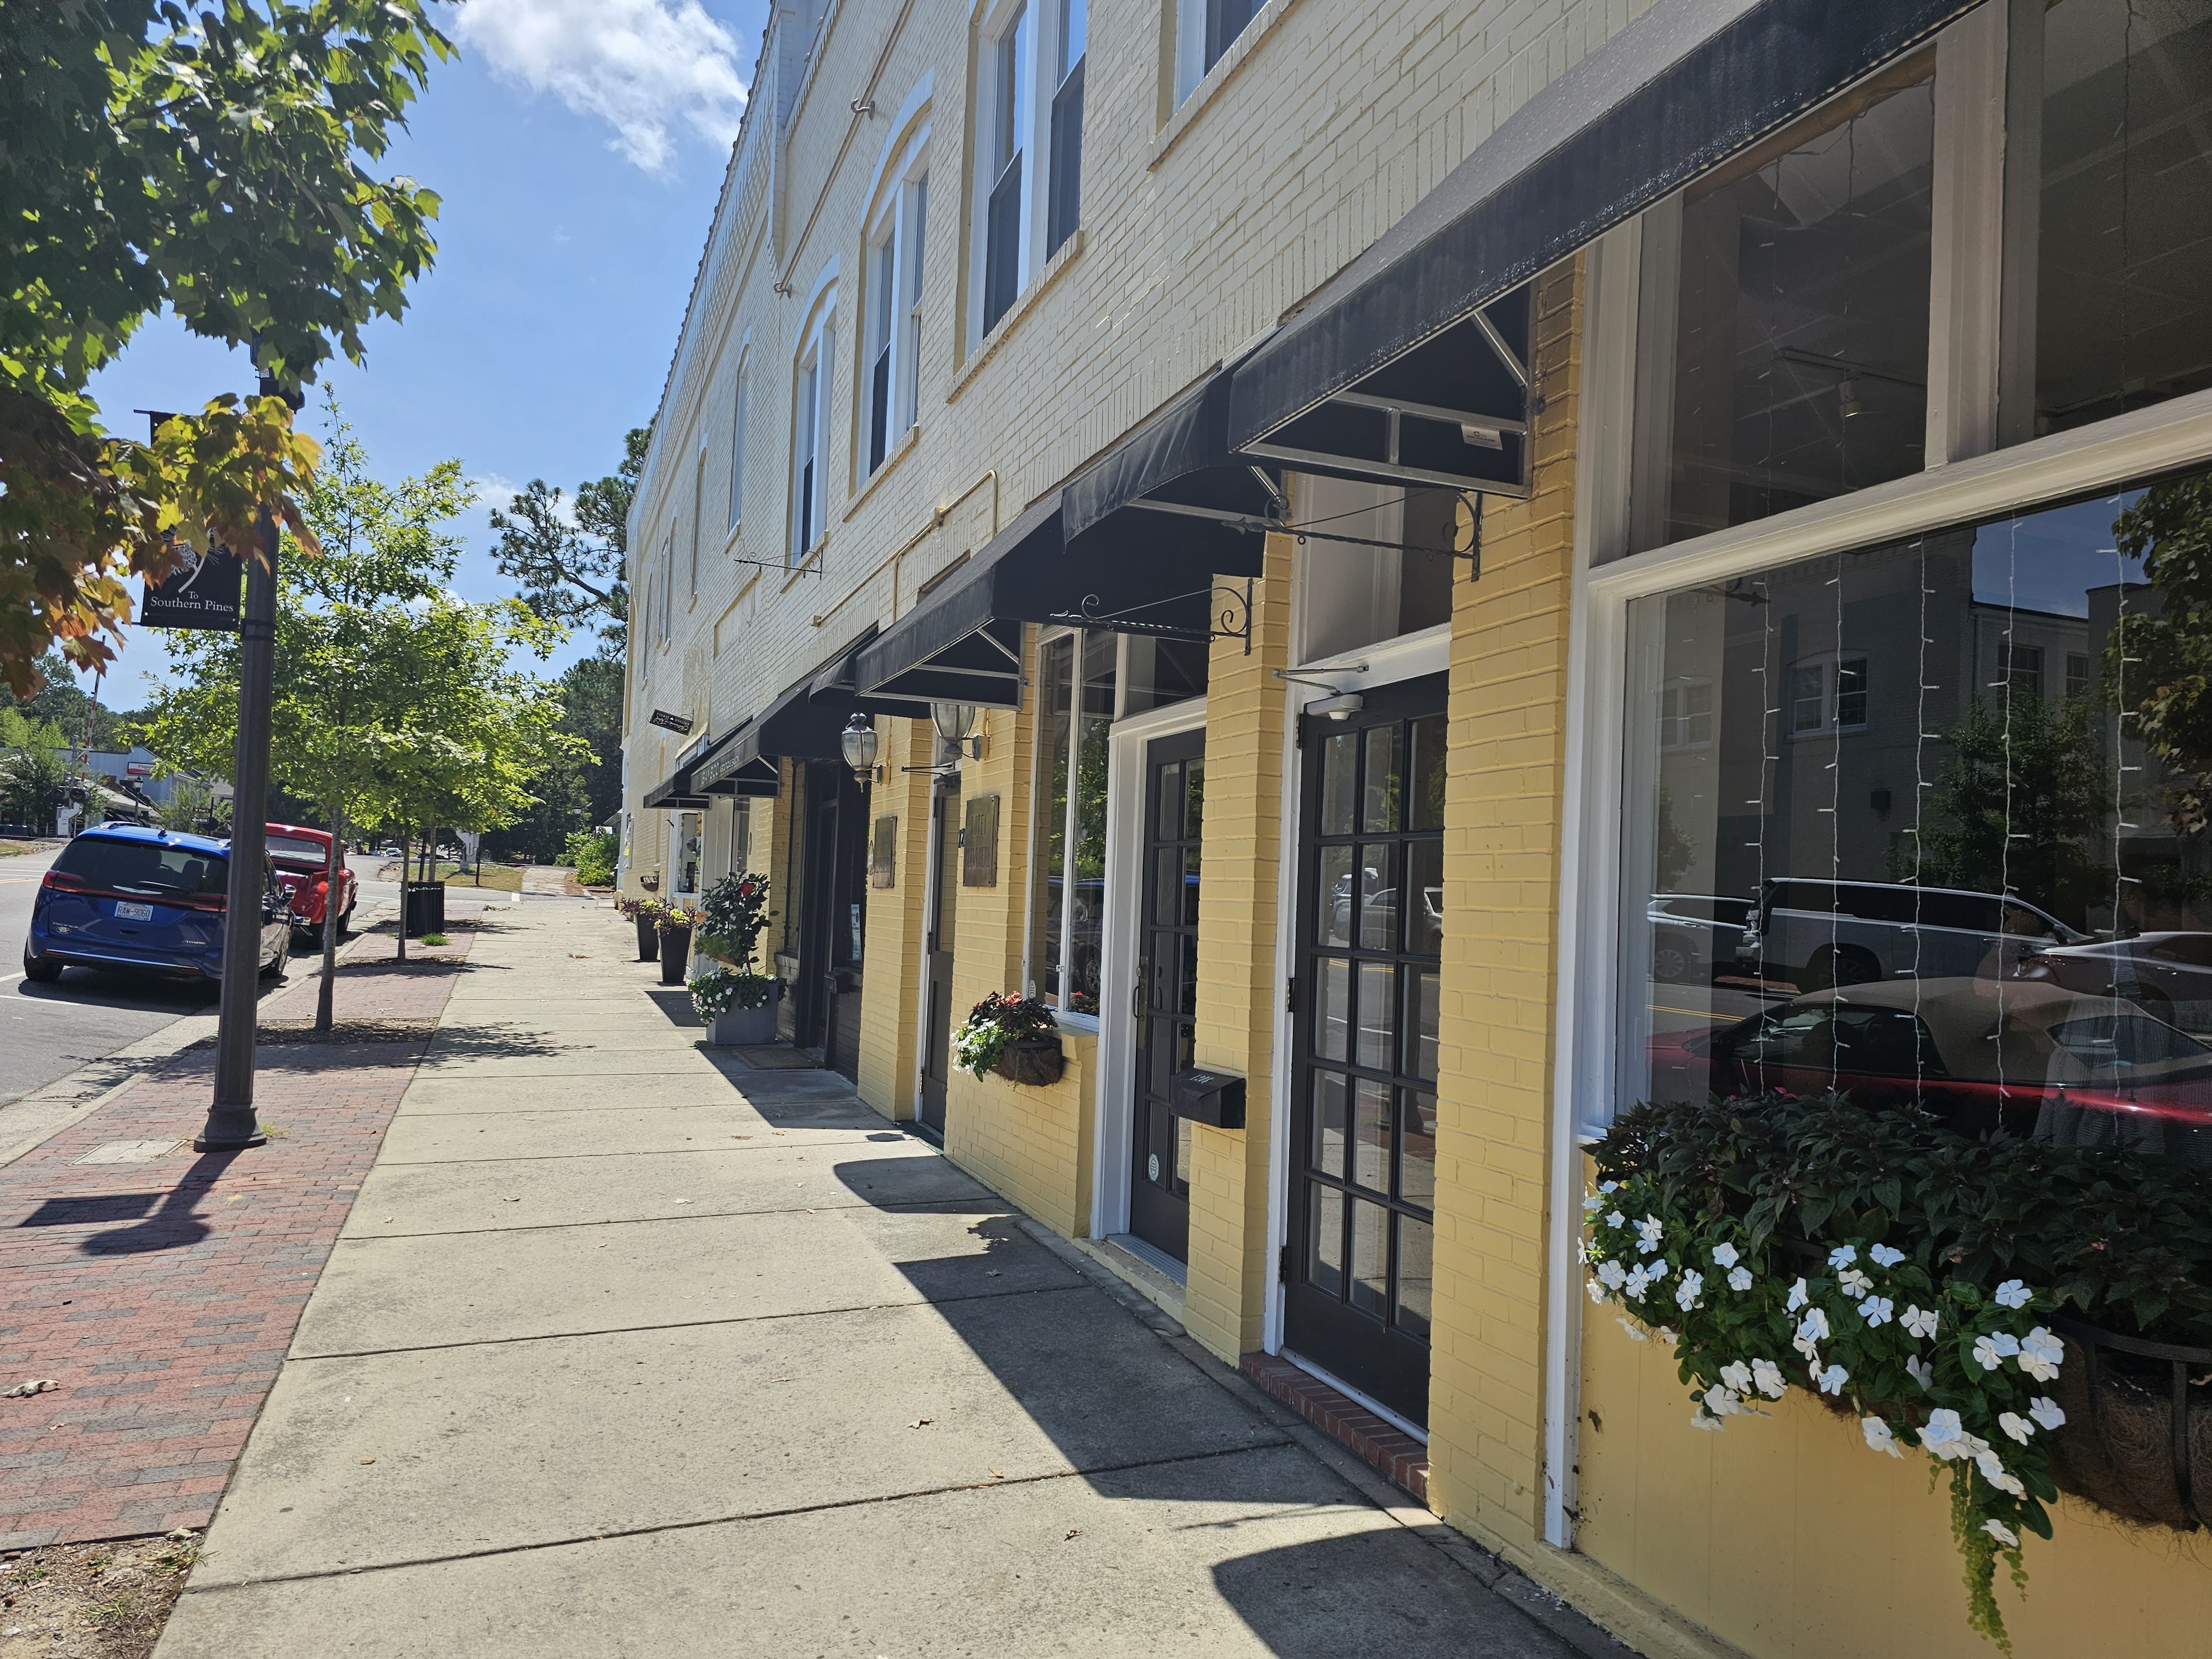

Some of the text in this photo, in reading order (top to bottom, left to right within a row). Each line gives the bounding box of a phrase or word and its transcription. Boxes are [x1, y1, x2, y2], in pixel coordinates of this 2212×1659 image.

[188, 591, 199, 599] To
[150, 596, 234, 612] Southern Pines
[970, 814, 987, 836] HOTEL
[117, 906, 150, 917] RAW-9060
